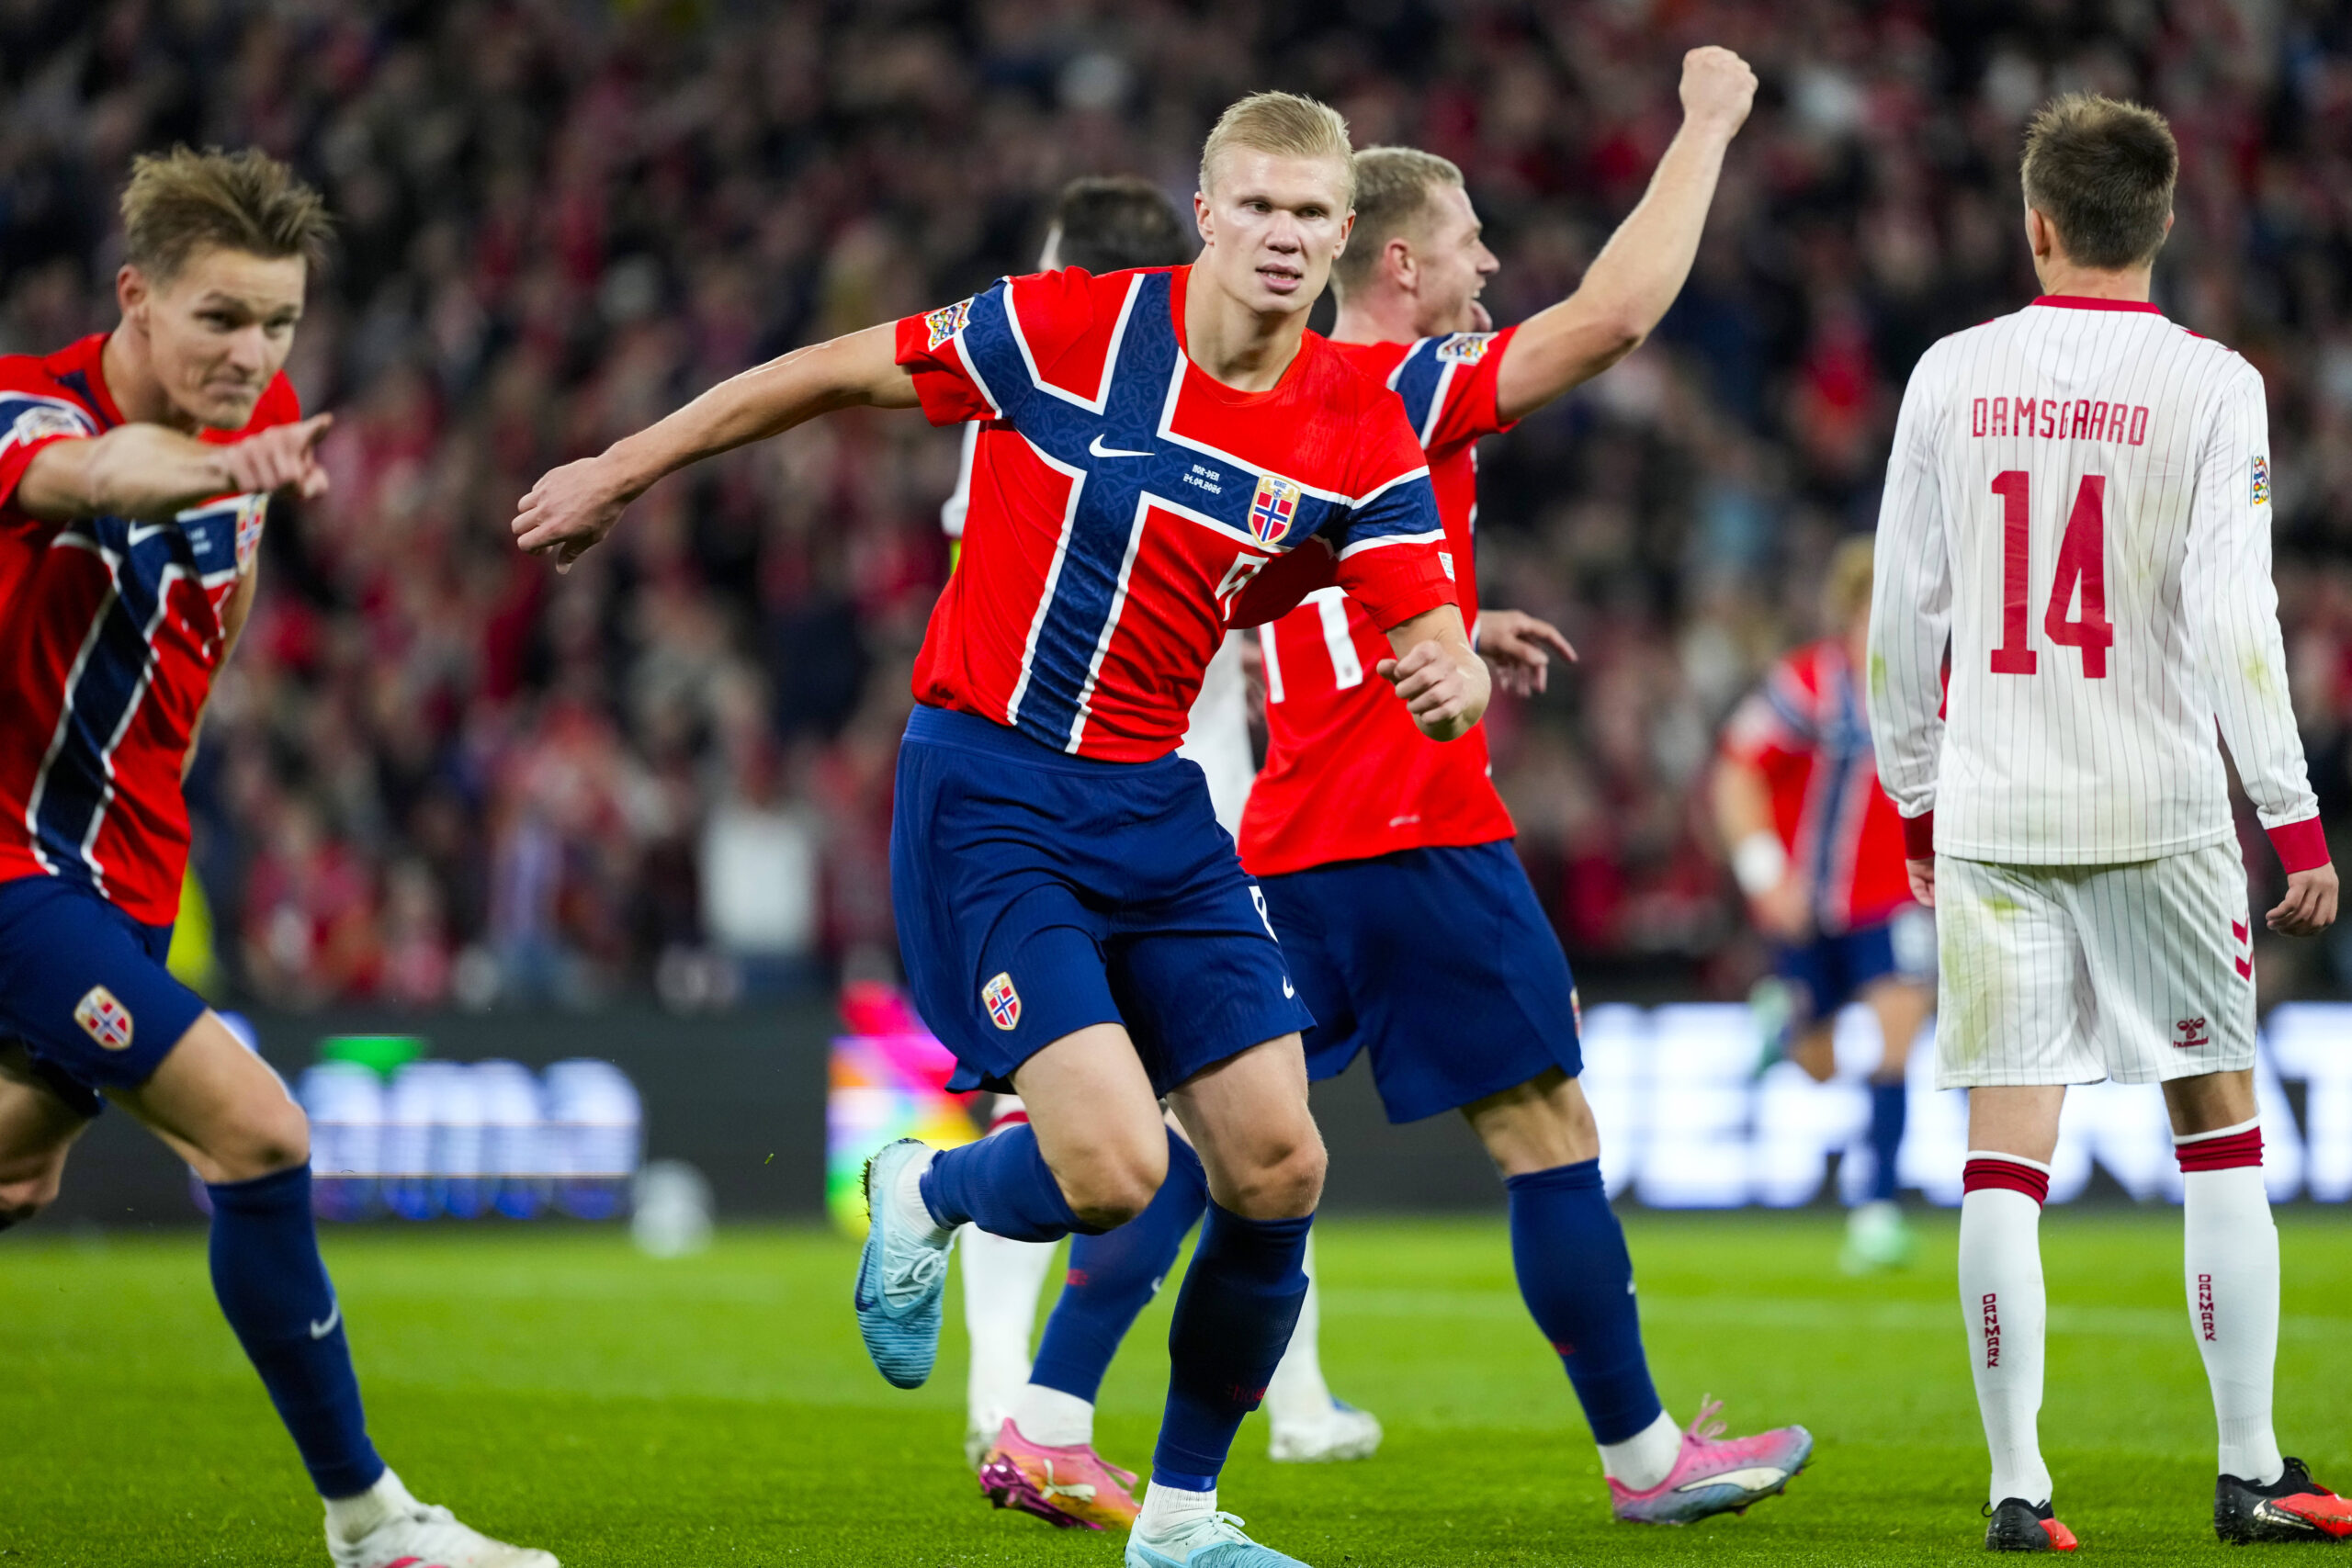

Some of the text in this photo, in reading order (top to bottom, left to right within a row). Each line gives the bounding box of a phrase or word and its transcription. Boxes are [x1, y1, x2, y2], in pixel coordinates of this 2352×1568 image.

[1973, 396, 2150, 446] DAMSGAARD
[1990, 469, 2113, 679] 14
[1982, 1292, 2001, 1370] DANMARK
[2198, 1273, 2217, 1342] DANMARK
